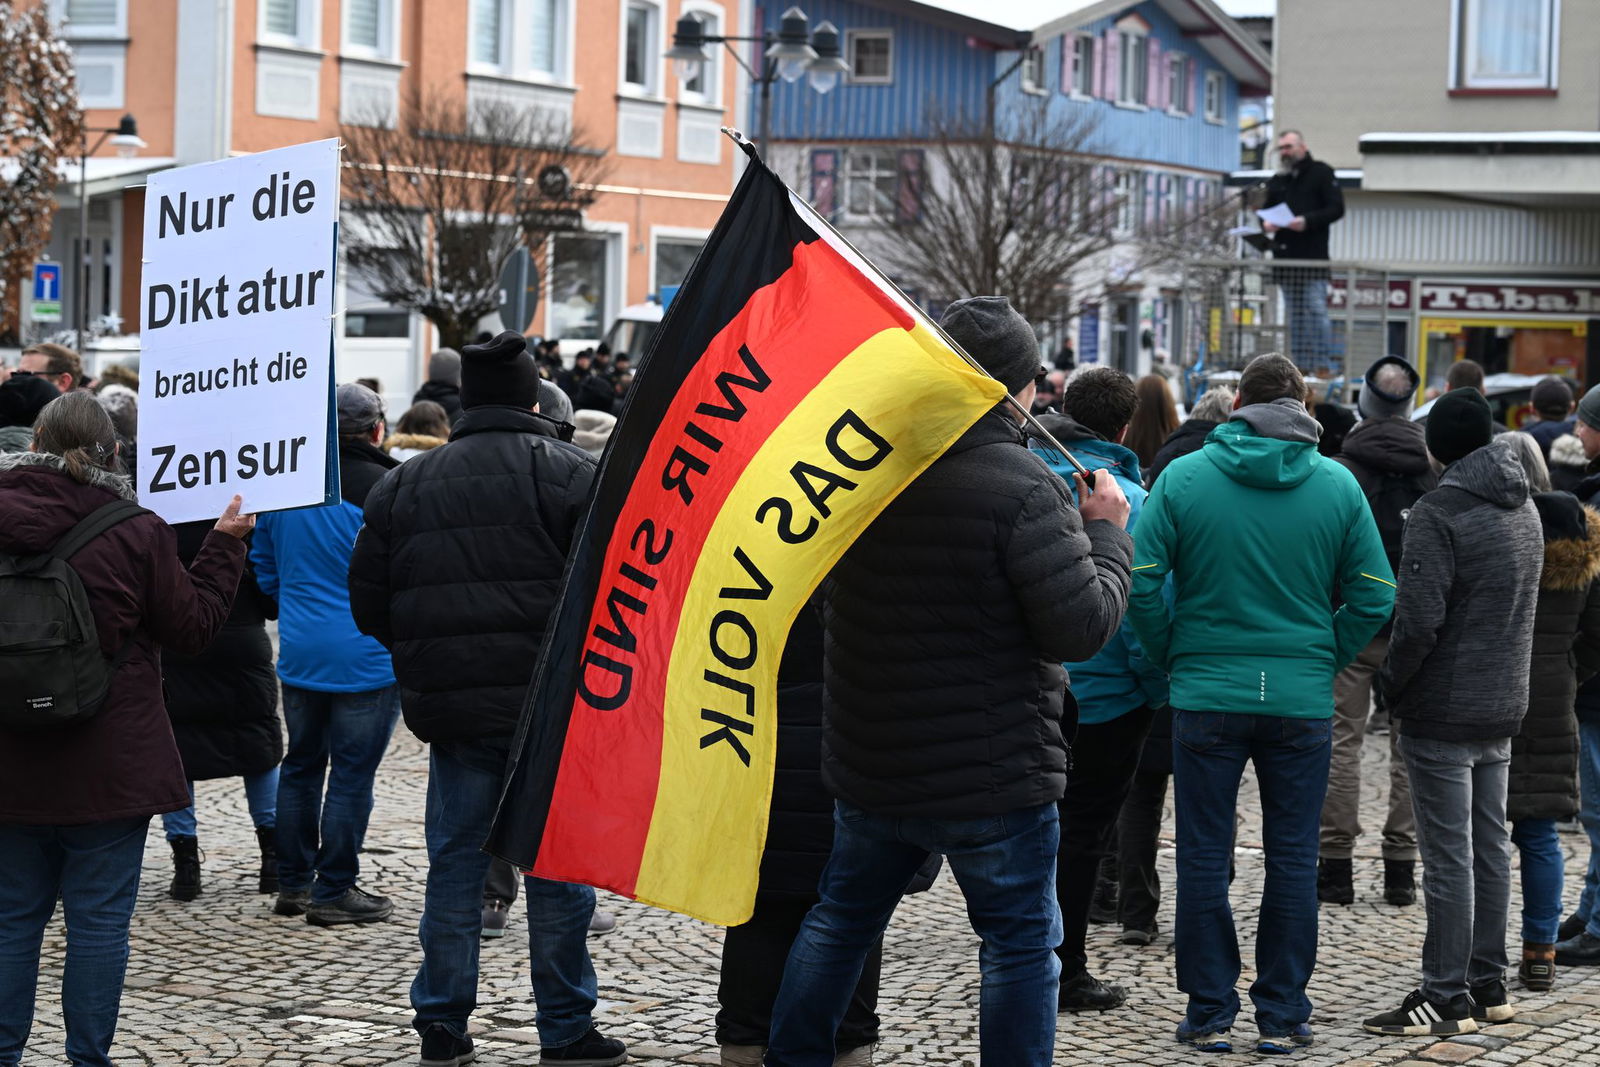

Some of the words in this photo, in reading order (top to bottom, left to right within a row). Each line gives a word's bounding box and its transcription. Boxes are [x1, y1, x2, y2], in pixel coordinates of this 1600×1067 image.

[158, 191, 235, 239] Nur
[252, 171, 316, 222] die
[148, 268, 325, 330] Diktatur
[154, 357, 259, 398] braucht
[266, 352, 308, 384] die
[149, 436, 307, 494] Zensur
